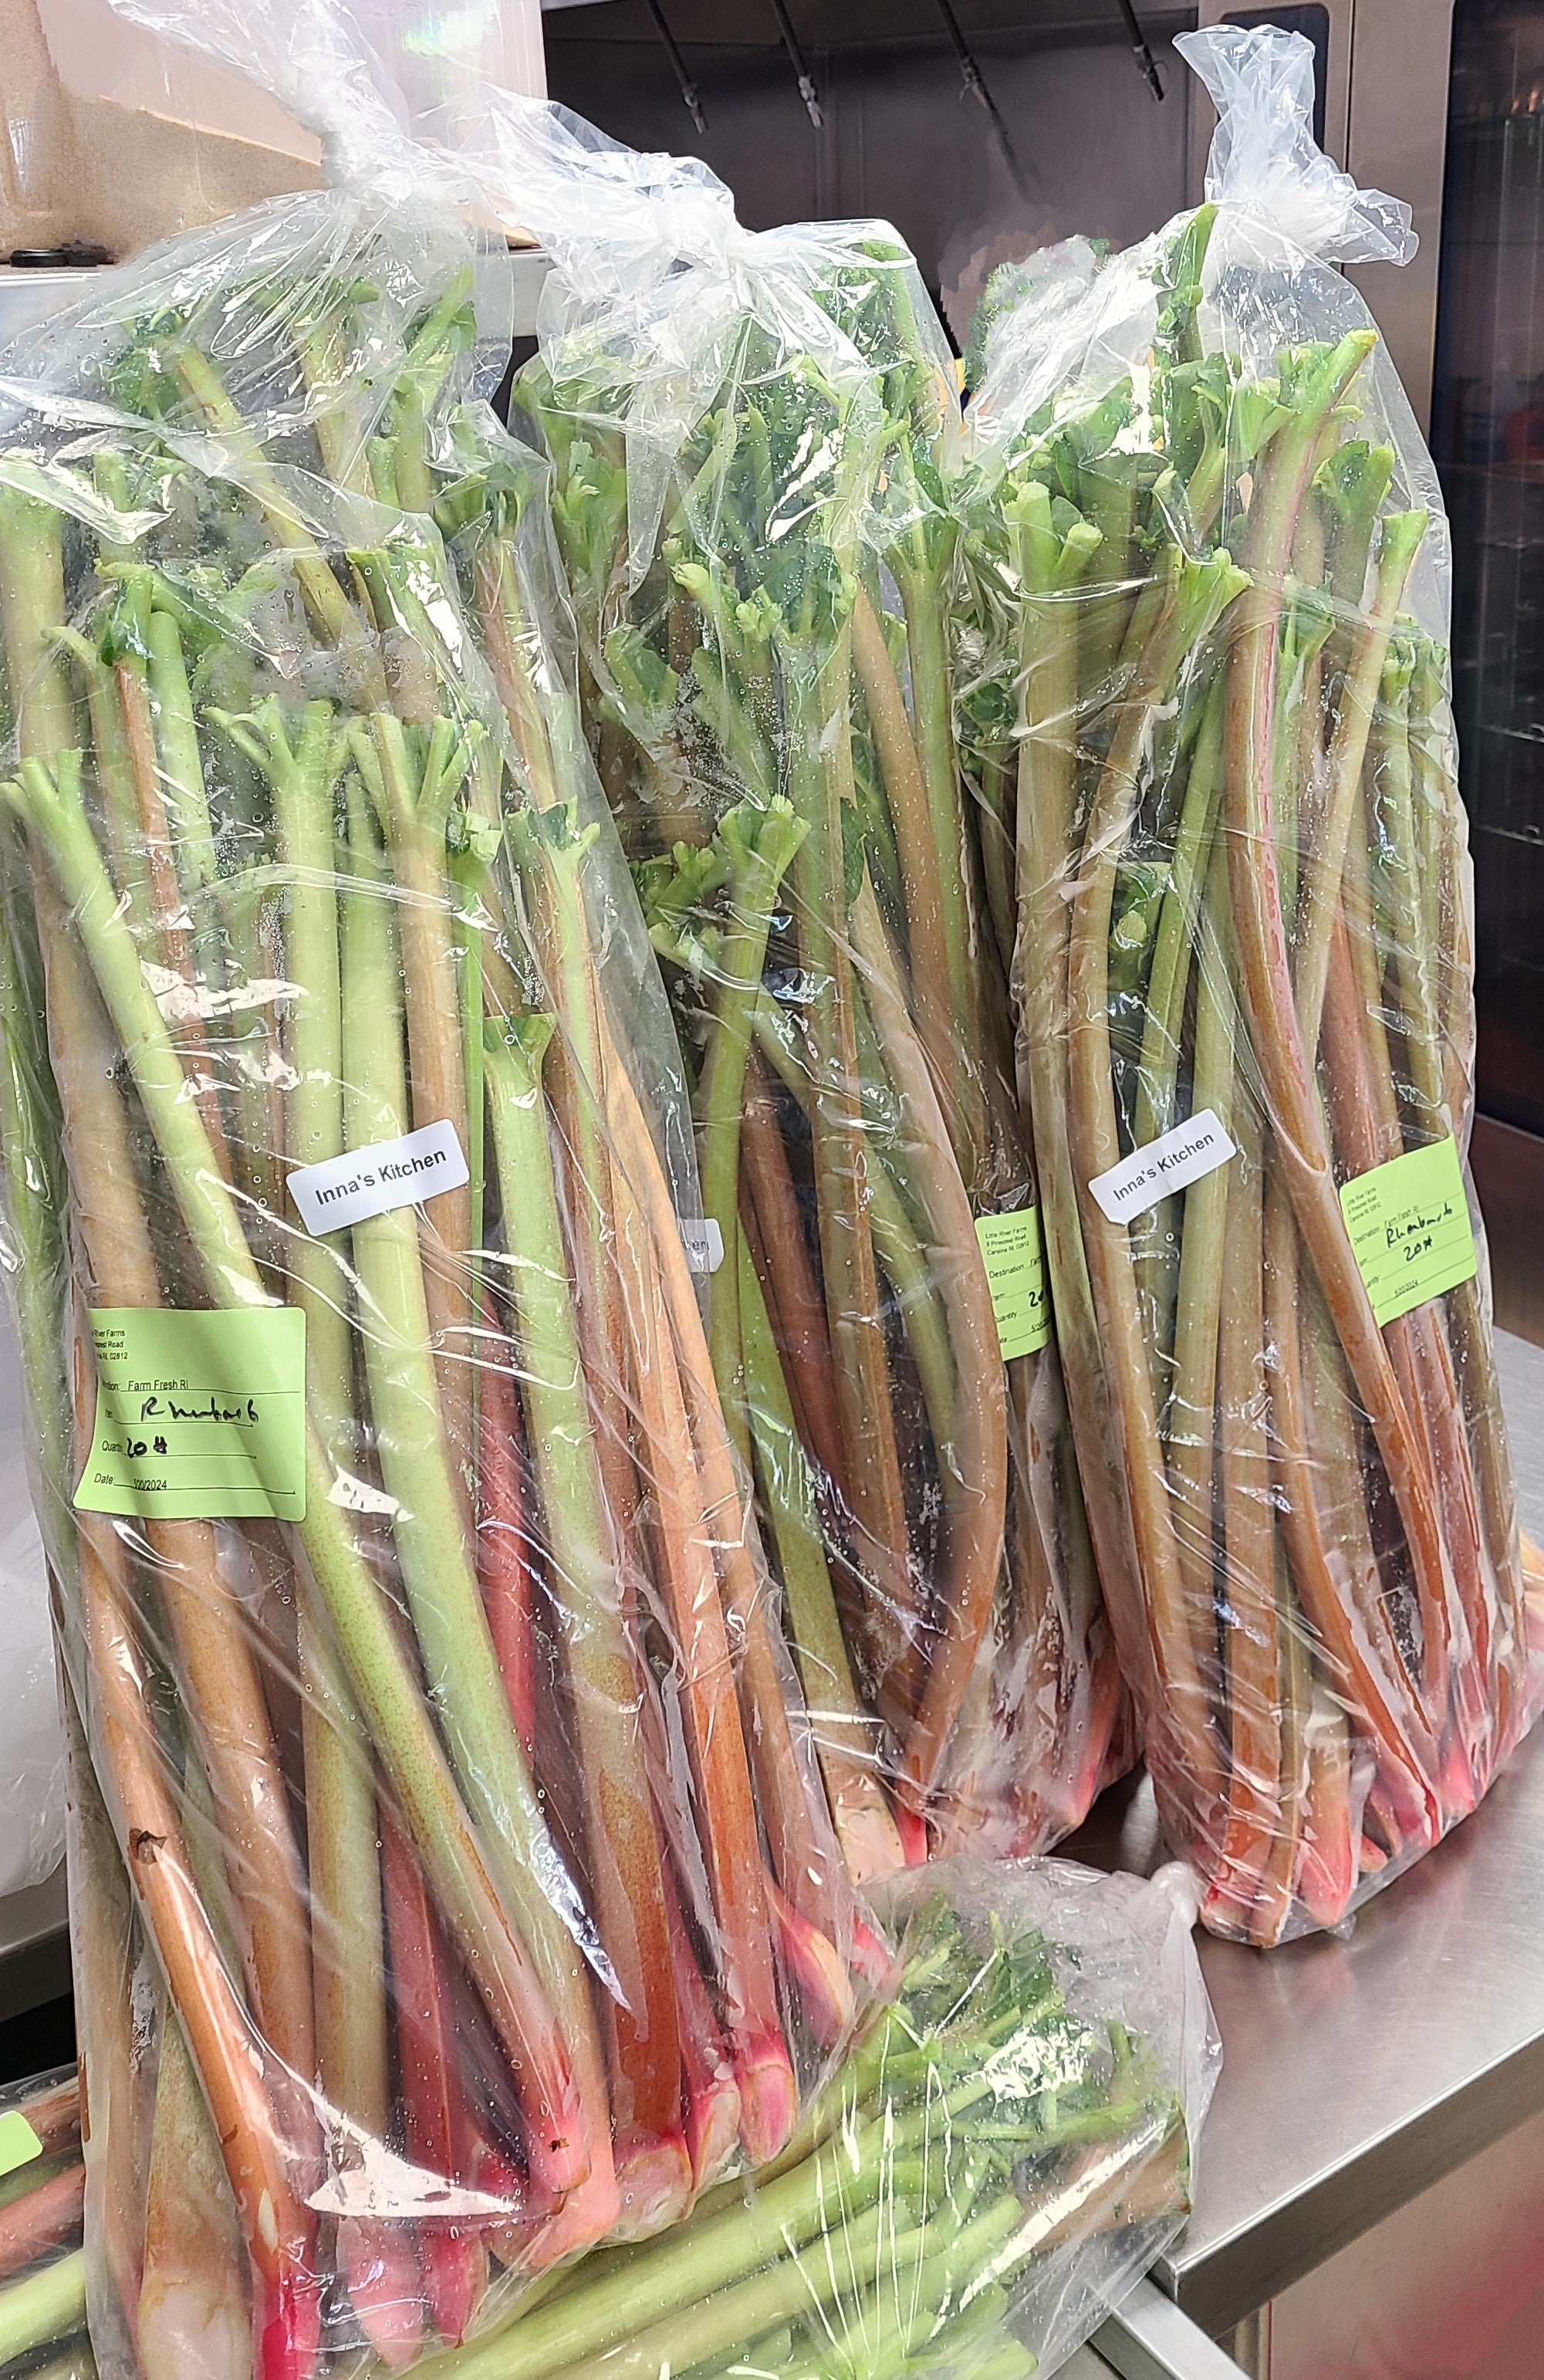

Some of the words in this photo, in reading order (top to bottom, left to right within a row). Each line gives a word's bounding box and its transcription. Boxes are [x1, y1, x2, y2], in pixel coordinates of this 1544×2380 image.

[315, 1175, 376, 1205] Inna's
[378, 1150, 447, 1182] Kitchen
[1113, 1168, 1157, 1201] Inna's
[1157, 1134, 1215, 1172] Kitchen
[128, 1381, 152, 1391] Farm
[154, 1380, 178, 1390] Fresh
[180, 1380, 189, 1388] RI
